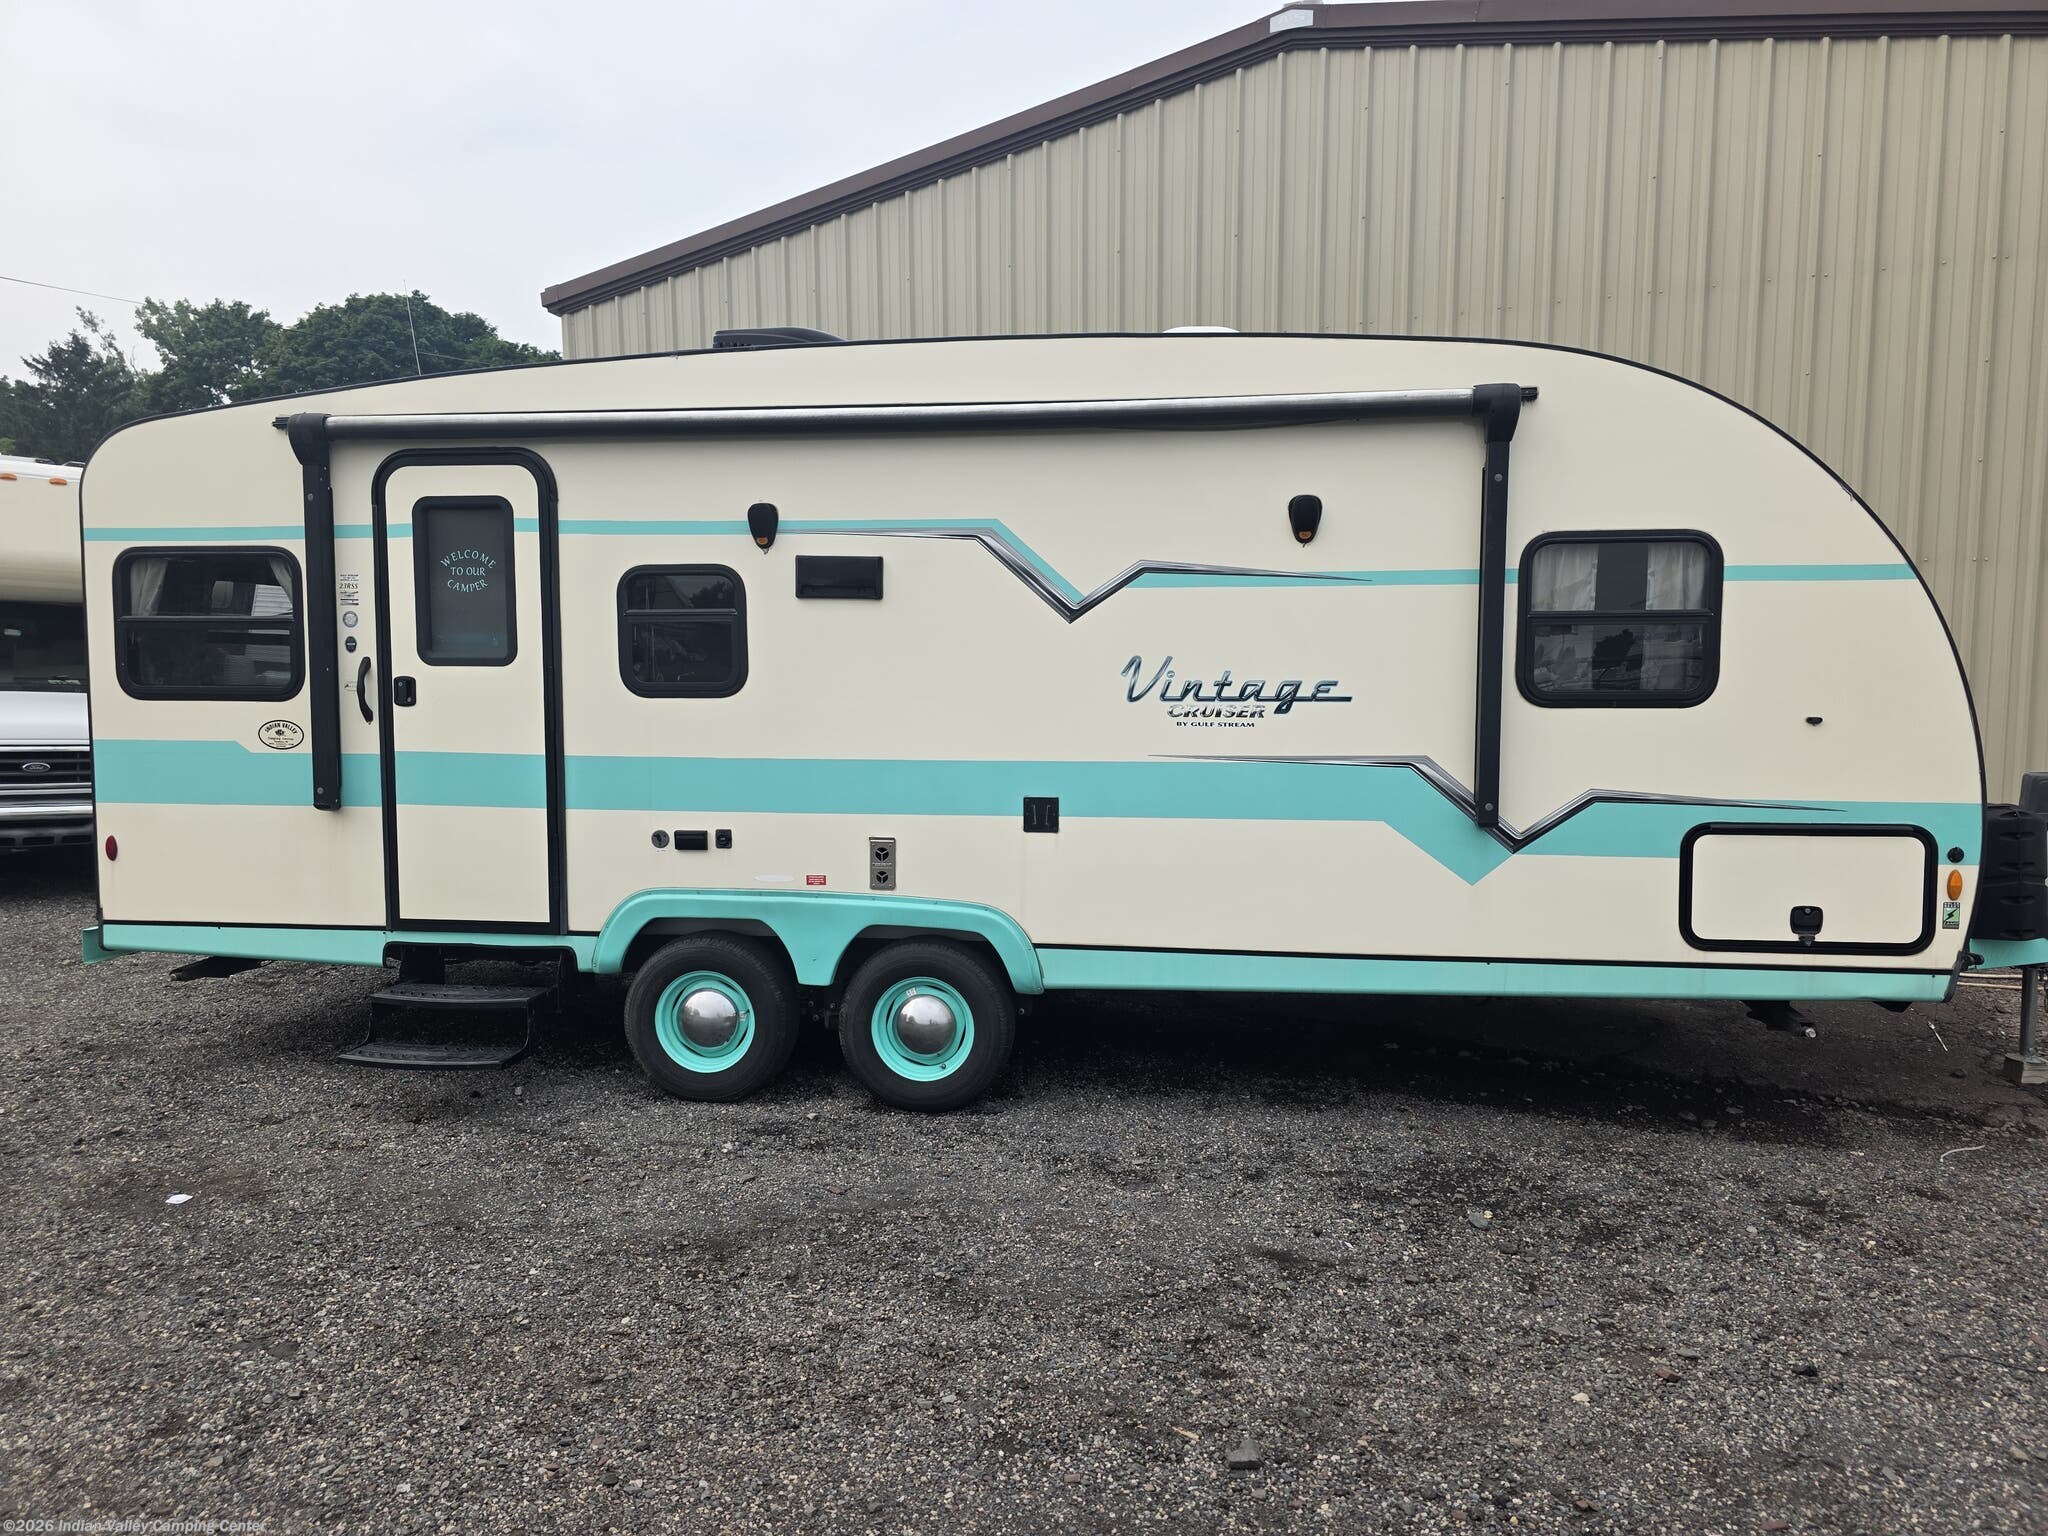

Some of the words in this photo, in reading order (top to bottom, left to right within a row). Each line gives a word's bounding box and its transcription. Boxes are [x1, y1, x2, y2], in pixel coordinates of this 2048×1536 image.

[440, 549, 497, 569] WELCOME
[450, 566, 463, 576] TO
[466, 566, 486, 576] OUR
[447, 579, 488, 593] CAMPER
[1120, 655, 1353, 714] Vintage
[1167, 704, 1266, 718] CRUISER
